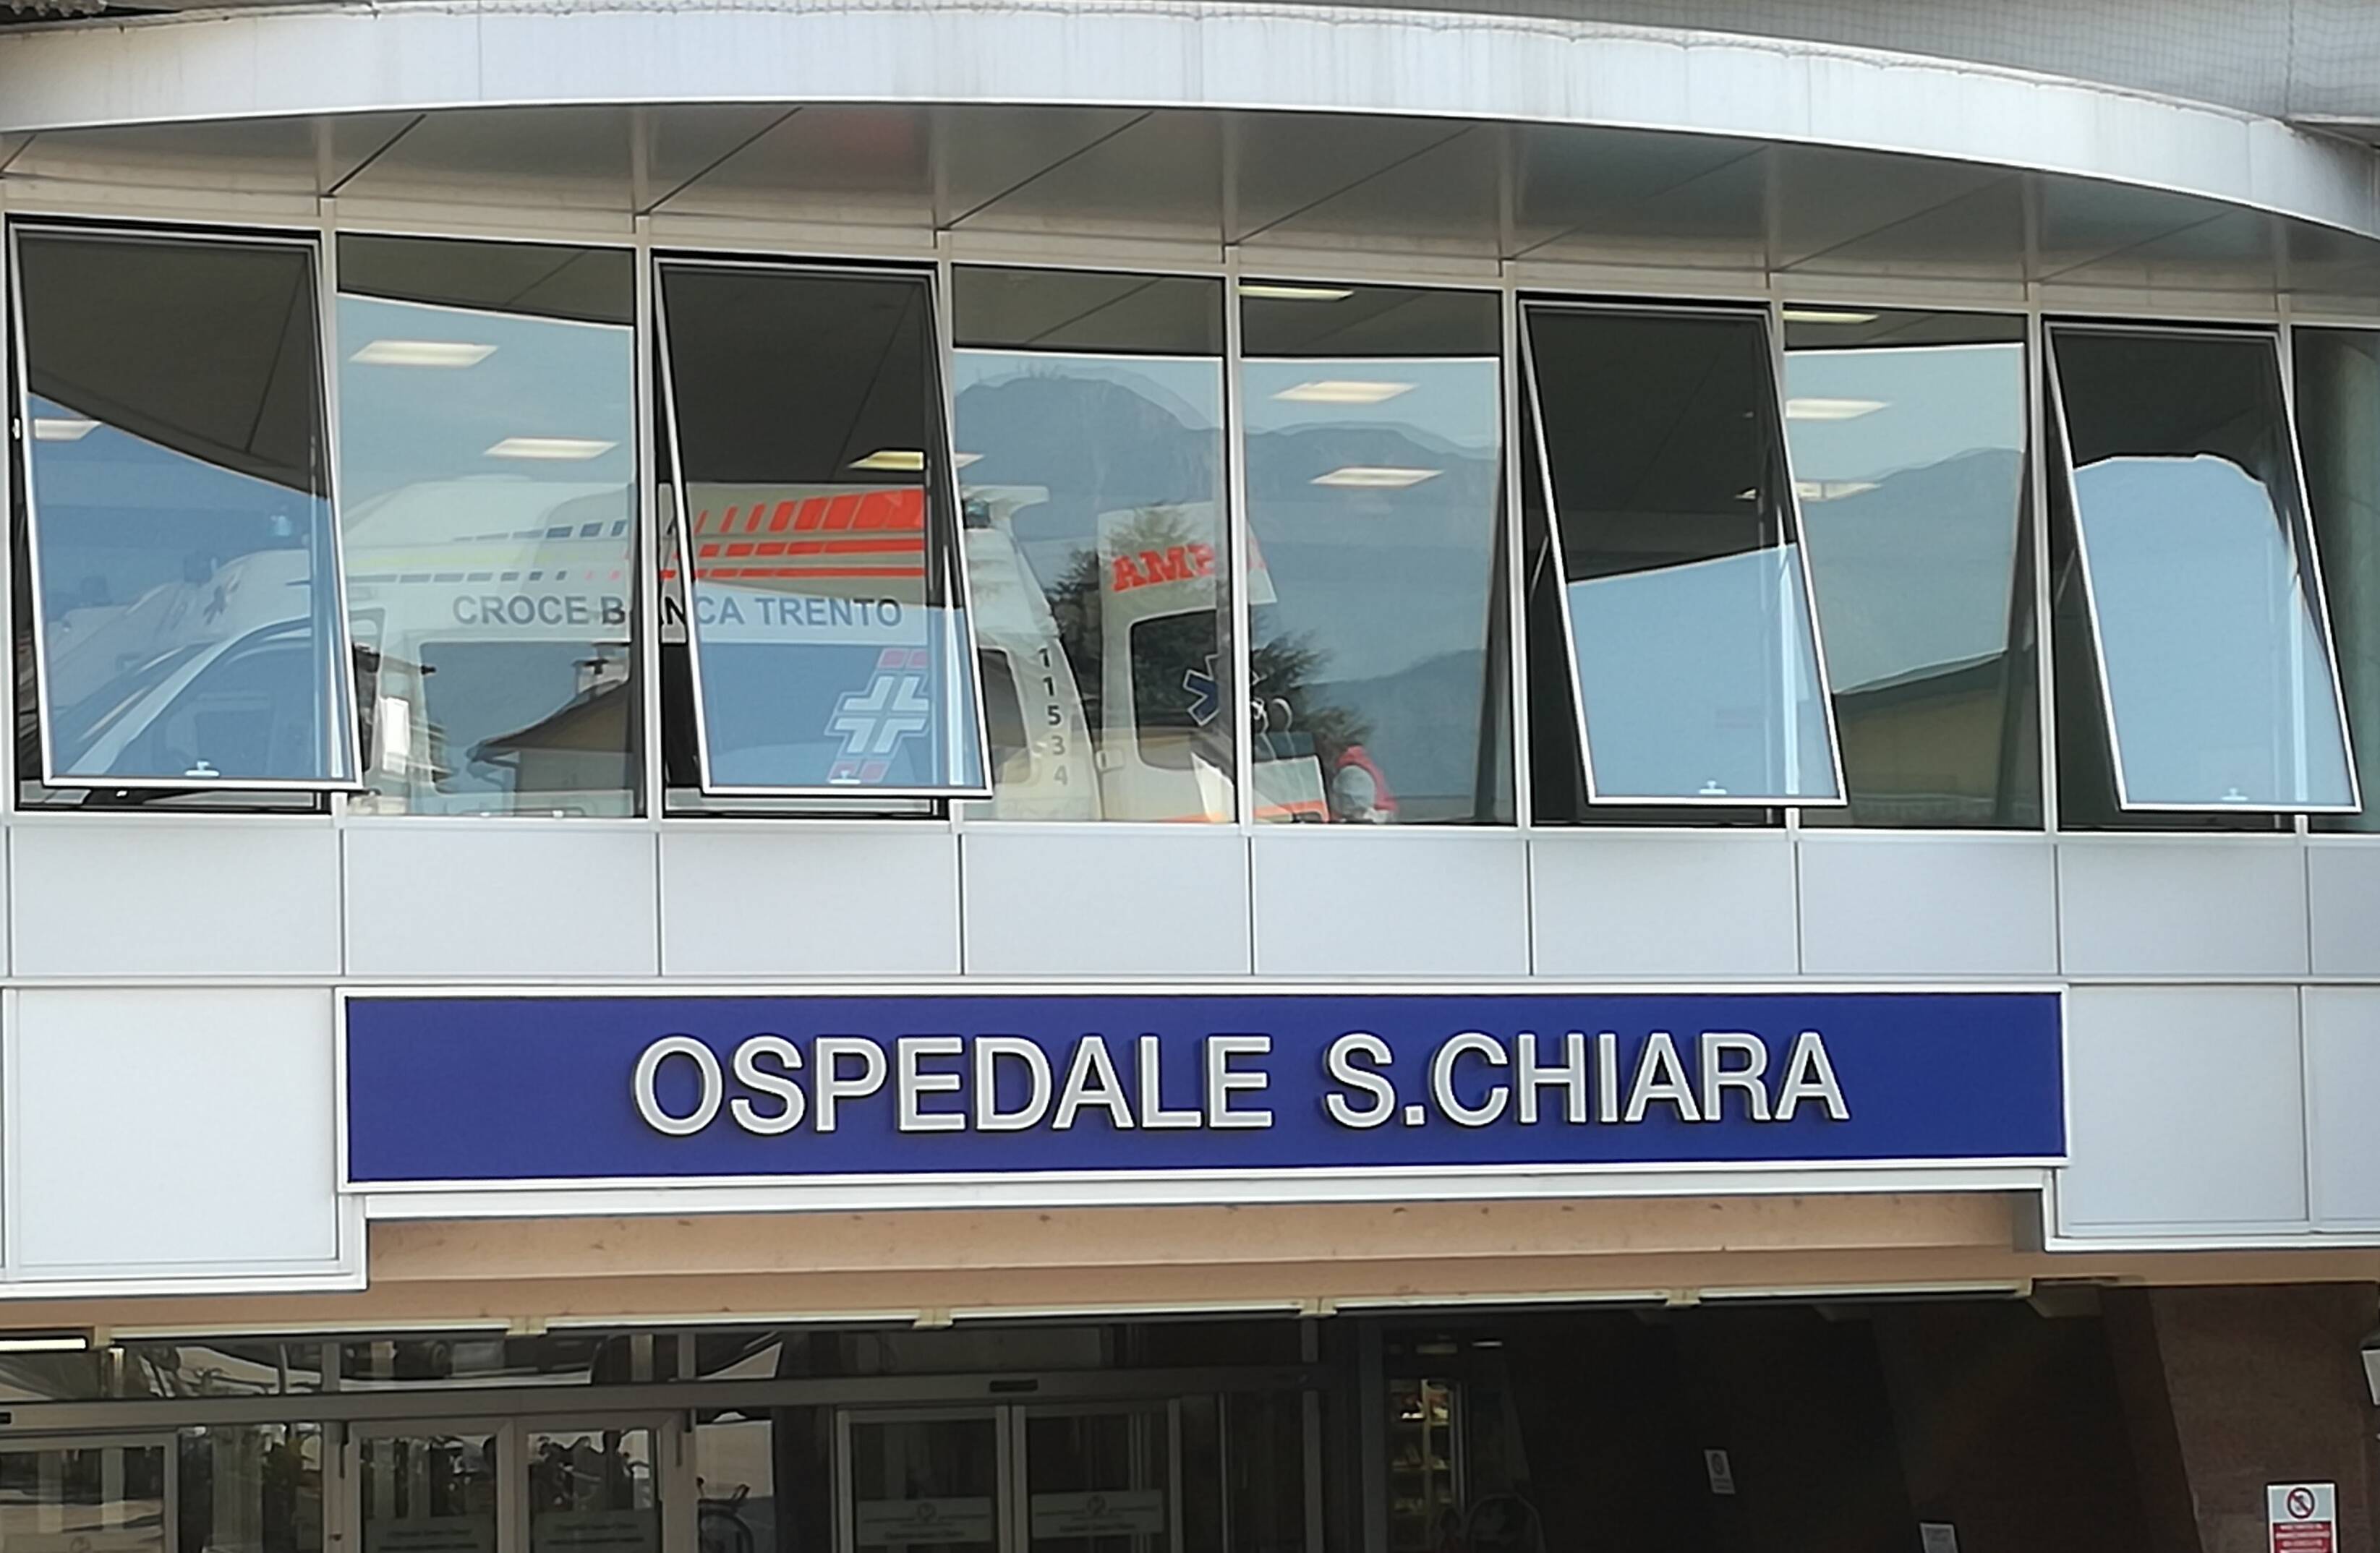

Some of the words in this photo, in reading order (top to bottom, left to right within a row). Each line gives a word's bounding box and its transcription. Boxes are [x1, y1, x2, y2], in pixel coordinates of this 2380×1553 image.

[453, 595, 589, 625] CROCE
[600, 596, 746, 626] BNCA
[754, 596, 903, 627] TRENTO
[1039, 648, 1068, 786] 11534
[632, 1035, 1273, 1135] OSPEDALE
[1325, 1032, 1851, 1127] S.CHIARA
